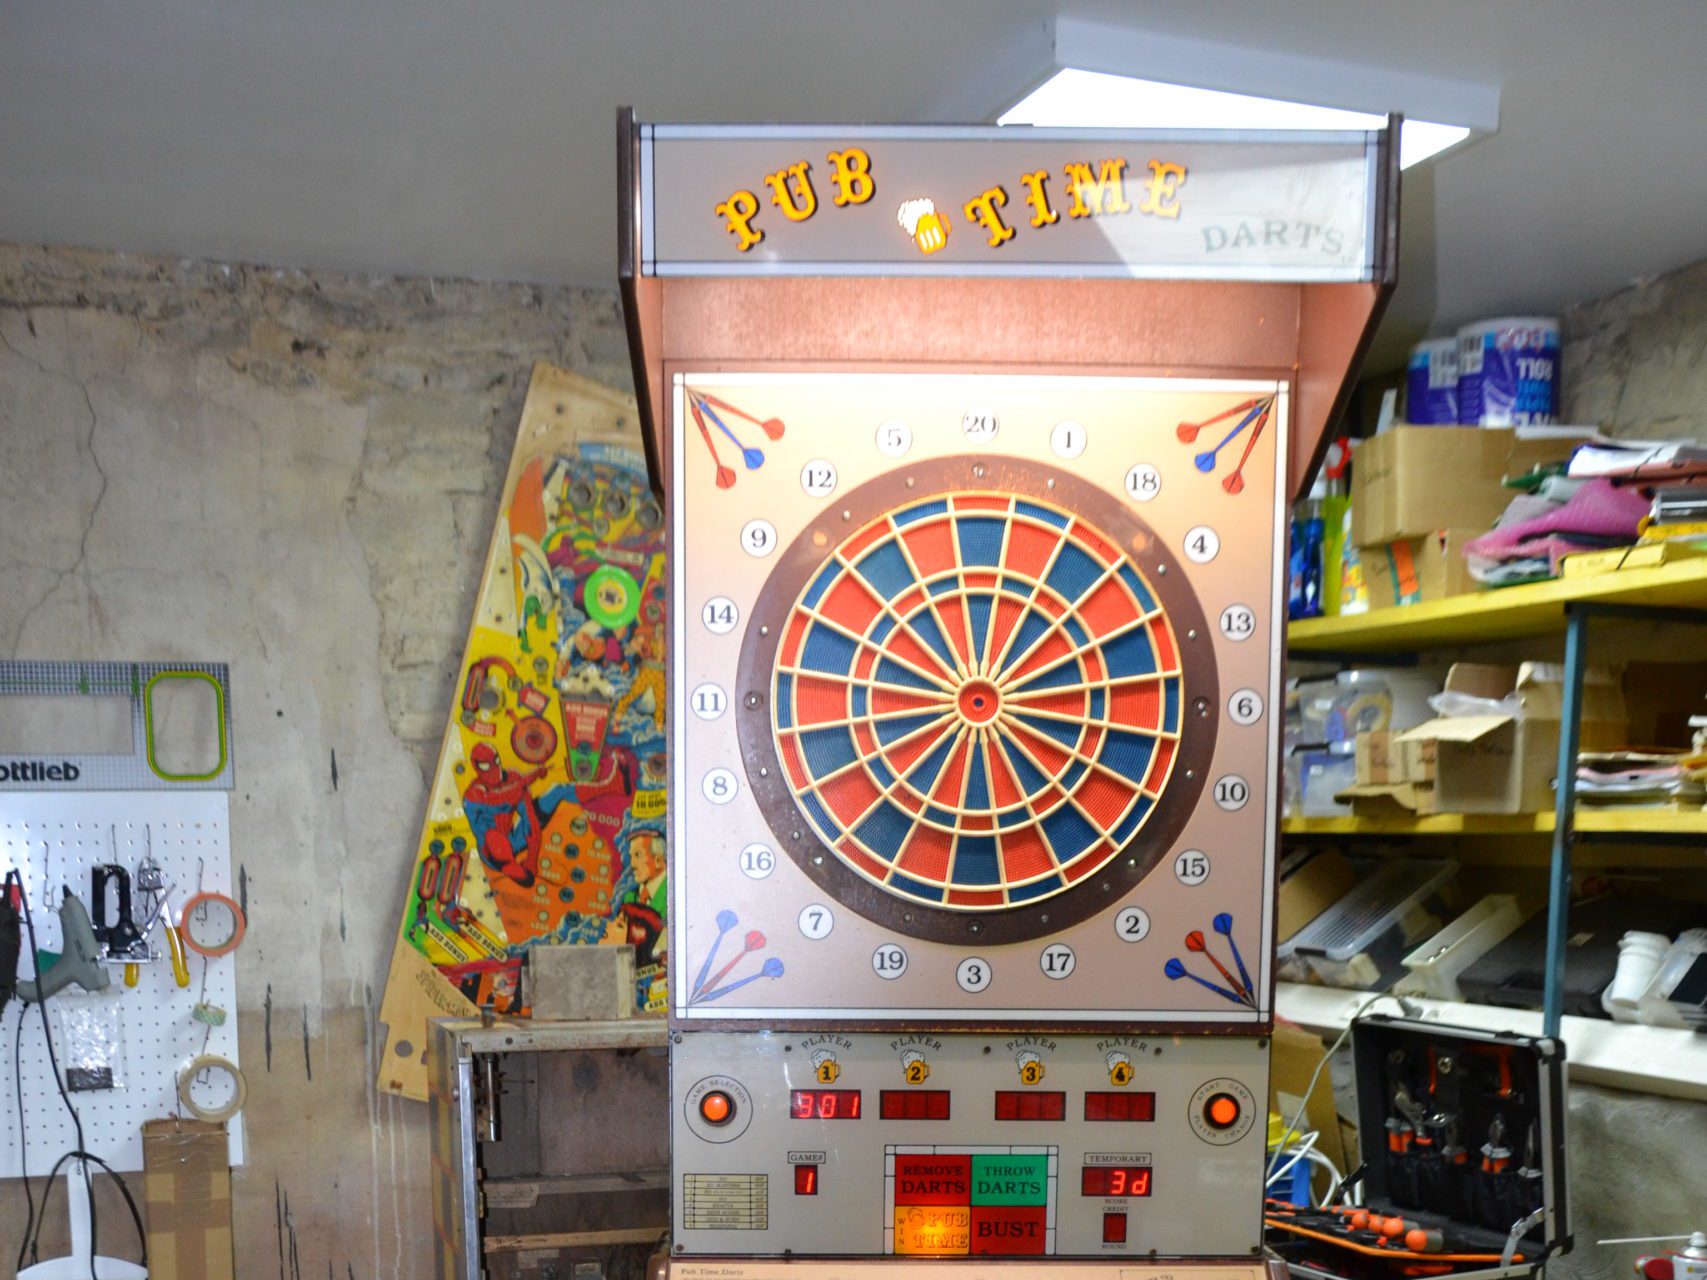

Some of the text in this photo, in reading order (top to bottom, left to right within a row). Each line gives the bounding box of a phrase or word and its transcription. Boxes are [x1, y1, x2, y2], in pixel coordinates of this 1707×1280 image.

[715, 147, 1189, 252] PUB TIME
[1202, 218, 1343, 256] DARTS
[965, 413, 997, 435] 20
[887, 428, 902, 449] 5
[1063, 428, 1073, 450] 1
[806, 468, 832, 488] 12
[1130, 472, 1157, 492] 18
[752, 527, 767, 549] 9
[1192, 534, 1208, 556] 4
[709, 605, 733, 625] 14
[1224, 613, 1251, 632] 13
[697, 692, 721, 712] 11
[1238, 698, 1253, 717] 6
[712, 776, 728, 795] 8
[1219, 783, 1246, 802] 10
[747, 852, 771, 871] 16
[1180, 858, 1205, 878] 15
[809, 912, 824, 932] 7
[1125, 916, 1140, 935] 2
[878, 952, 904, 972] 19
[1046, 952, 1071, 972] 17
[966, 966, 983, 985] 3
[801, 1034, 852, 1049] PLAYER
[891, 1035, 942, 1050] PLAYER
[1006, 1035, 1057, 1051] PLAYER
[1096, 1036, 1148, 1052] PLAYER
[822, 1065, 831, 1081] 1
[911, 1066, 921, 1081] 2
[1026, 1066, 1035, 1082] 3
[1115, 1067, 1125, 1082] 4
[690, 1079, 747, 1105] GAME SELECTION
[1198, 1082, 1248, 1101] START GAME
[799, 1094, 860, 1118] 301
[1194, 1114, 1217, 1138] PLAYER
[790, 1154, 824, 1162] GAME#
[1089, 1155, 1148, 1163] TEMPORARY
[903, 1166, 964, 1176] REMOVE
[984, 1166, 1036, 1176] THROW
[806, 1172, 814, 1193] 1
[902, 1180, 966, 1194] DARTS
[977, 1181, 1041, 1195] DARTS
[927, 1212, 969, 1227] PUB
[977, 1221, 1040, 1237] BUST
[913, 1233, 968, 1249] TIME
